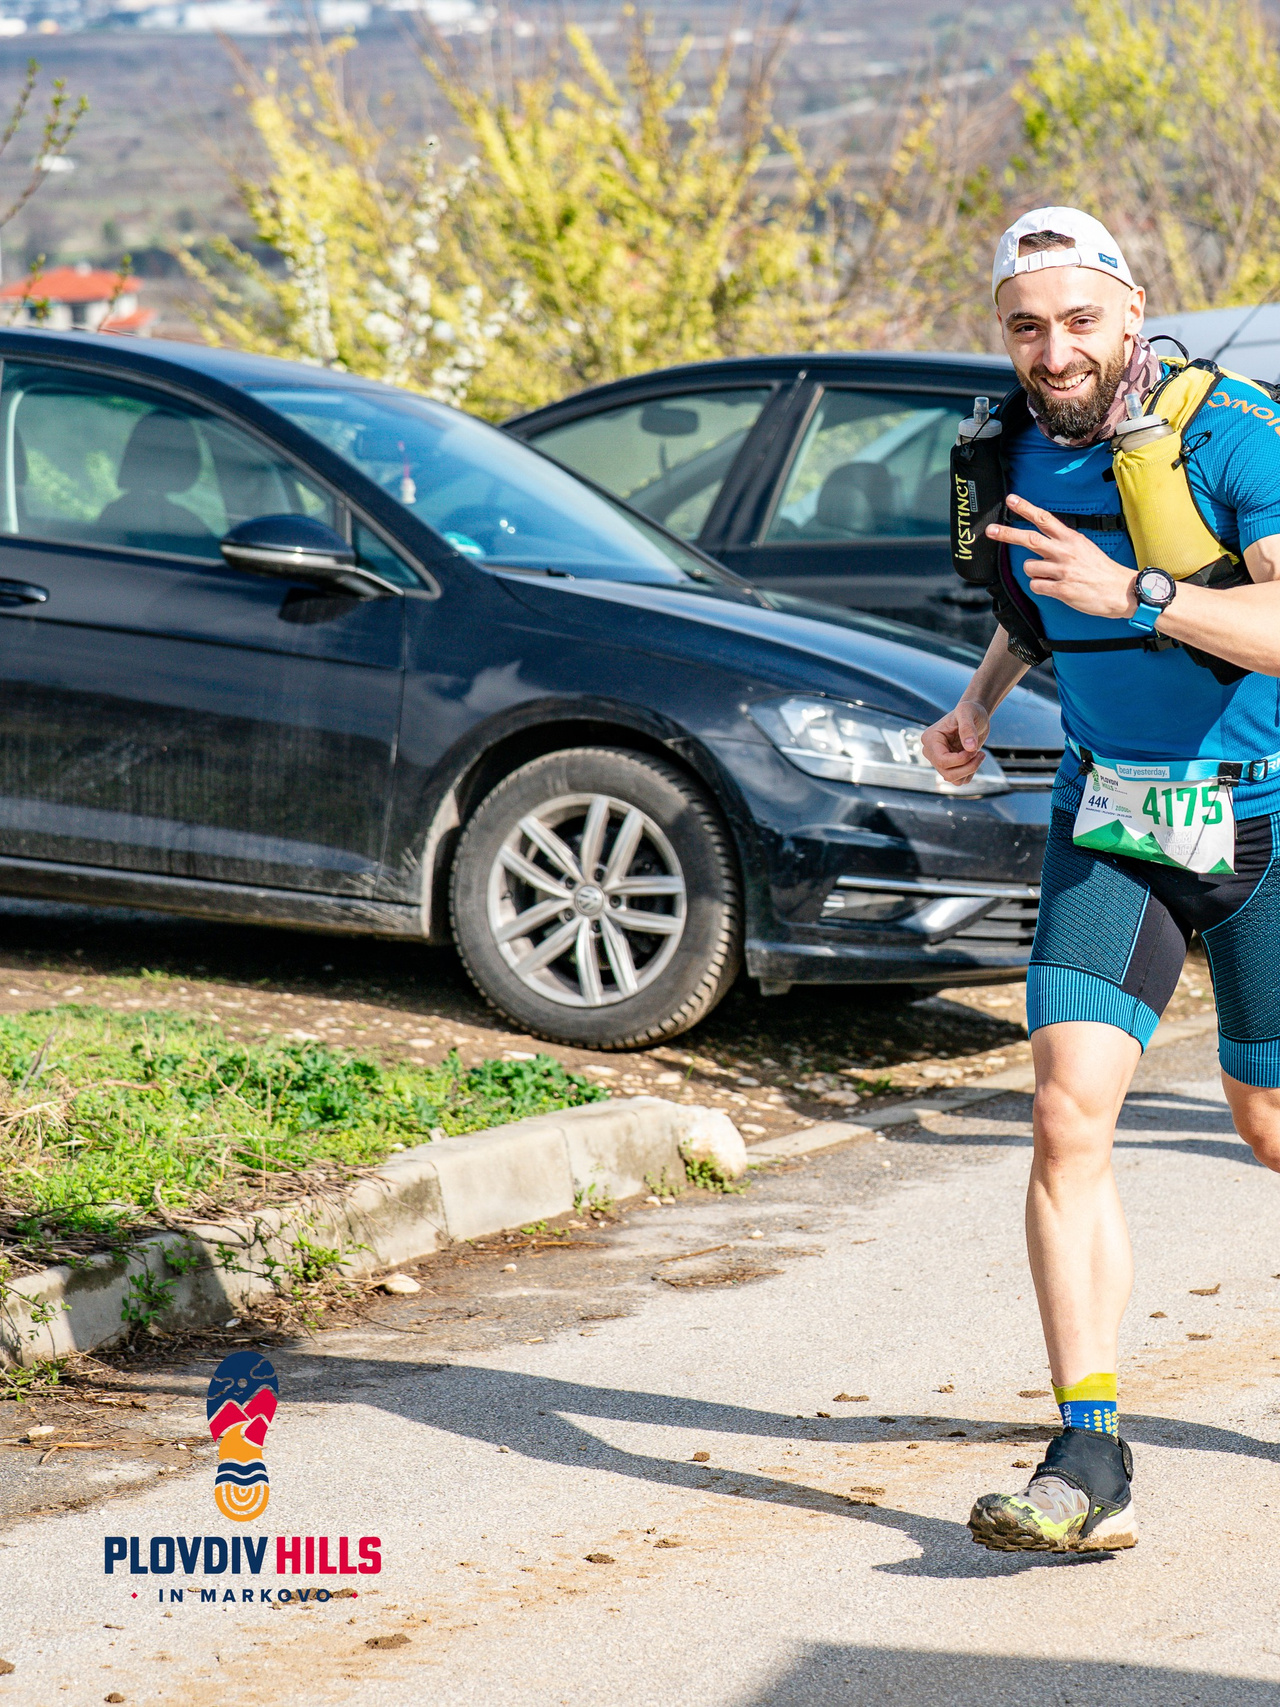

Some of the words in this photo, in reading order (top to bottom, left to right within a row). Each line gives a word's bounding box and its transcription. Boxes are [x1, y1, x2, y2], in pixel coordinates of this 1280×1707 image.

[1118, 766, 1132, 774] beat
[1133, 768, 1168, 777] yesterday.
[1088, 795, 1109, 809] 44K
[1142, 786, 1223, 828] 4175
